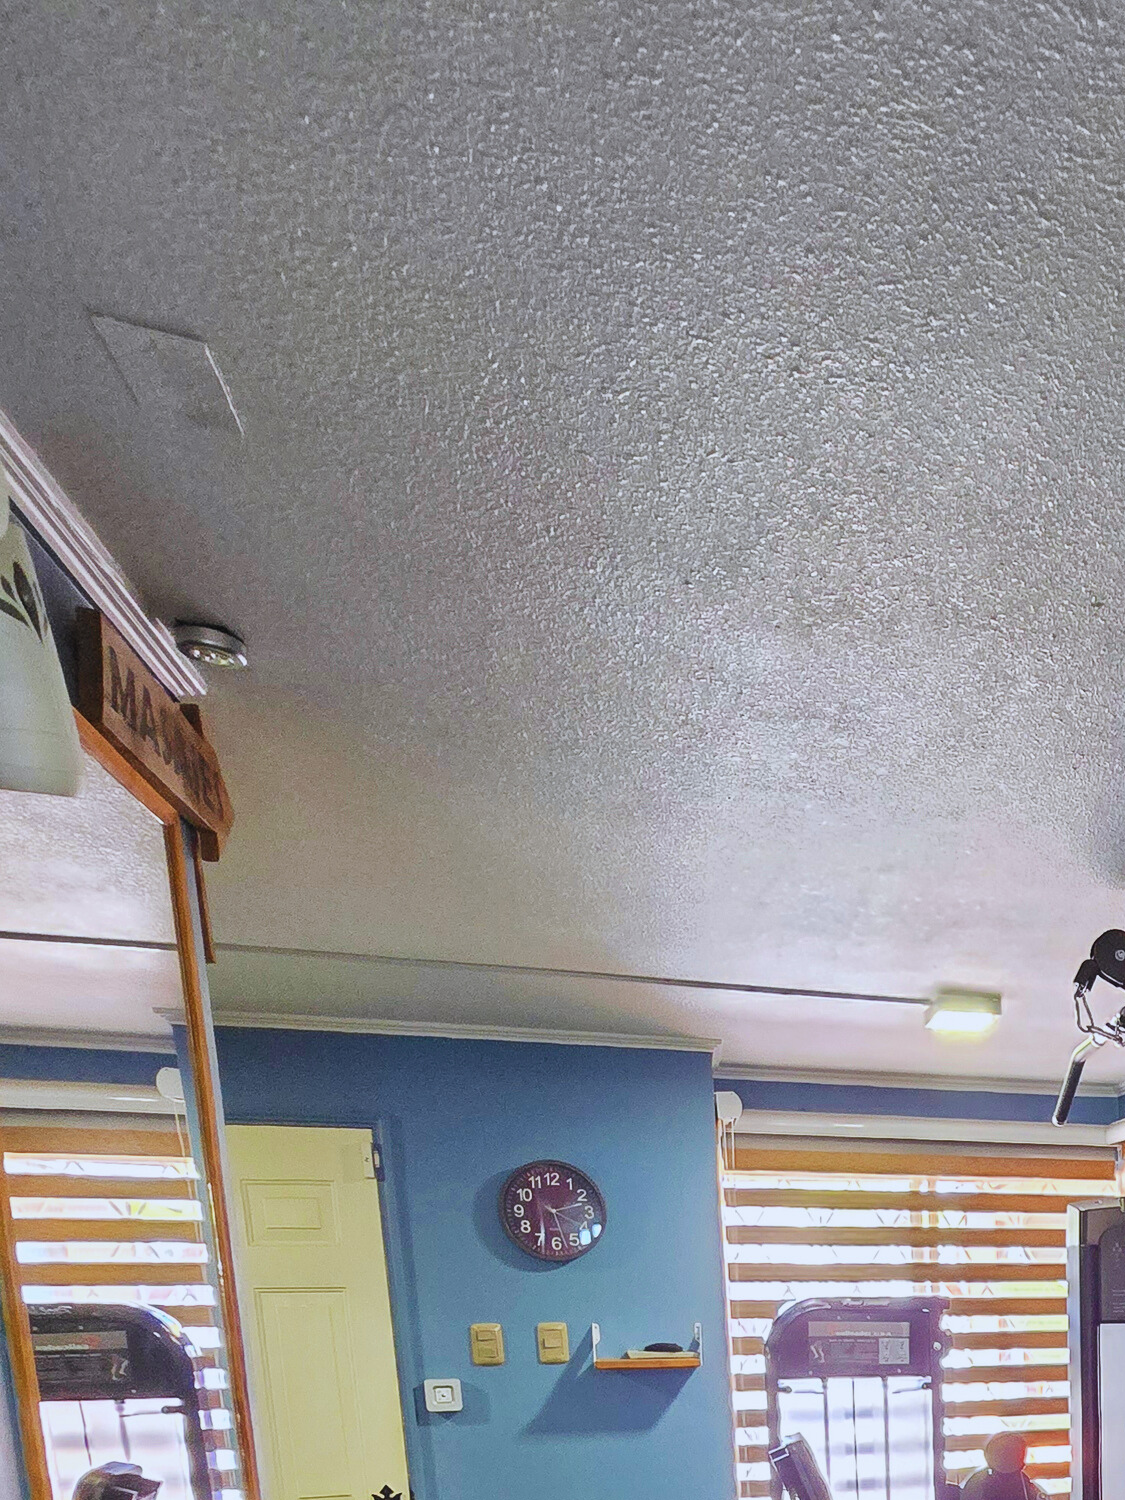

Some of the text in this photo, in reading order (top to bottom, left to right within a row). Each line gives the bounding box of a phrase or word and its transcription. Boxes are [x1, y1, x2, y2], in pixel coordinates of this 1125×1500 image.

[528, 1175, 542, 1189] 11
[544, 1172, 560, 1186] 12
[566, 1177, 573, 1190] 1
[516, 1188, 533, 1202] 10
[576, 1189, 588, 1202] 2
[513, 1204, 525, 1218] 9
[584, 1205, 595, 1219] 3
[520, 1219, 532, 1234] 8
[534, 1232, 545, 1247] 7
[551, 1236, 562, 1250] 6
[569, 1232, 580, 1247] 5
